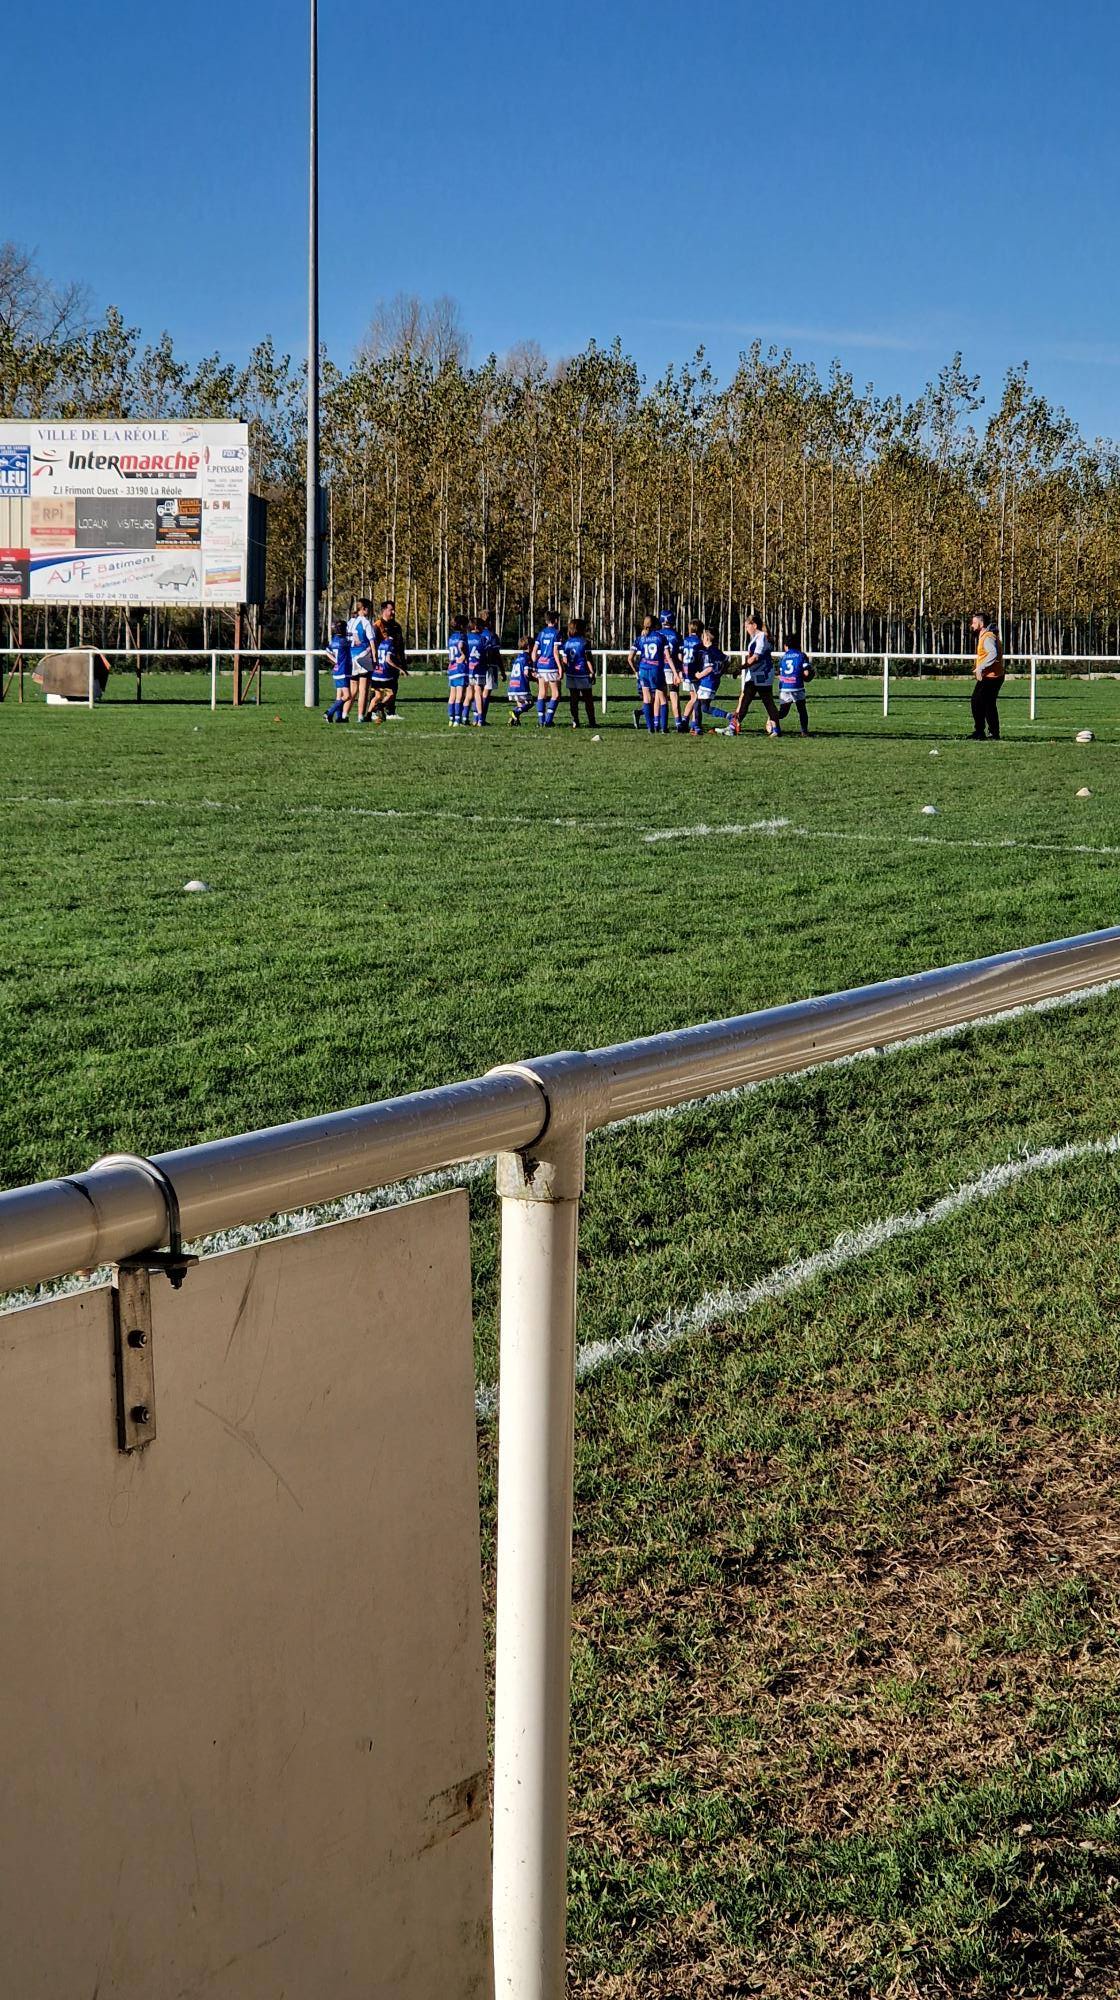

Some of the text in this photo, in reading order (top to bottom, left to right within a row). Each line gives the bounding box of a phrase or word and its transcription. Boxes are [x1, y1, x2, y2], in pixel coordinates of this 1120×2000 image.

[37, 429, 78, 441] VILLE
[81, 429, 100, 441] DE
[102, 429, 121, 441] LA
[124, 426, 170, 441] RÉOLE
[68, 449, 201, 479] Intermarché
[0, 470, 26, 487] LEU
[64, 485, 95, 495] Frimont
[96, 485, 119, 495] Ouest
[126, 485, 149, 496] 33190
[150, 485, 159, 496] La
[161, 485, 183, 496] Réole
[116, 518, 155, 530] VISITEURS
[643, 643, 657, 660] 19
[784, 659, 794, 675] 3
